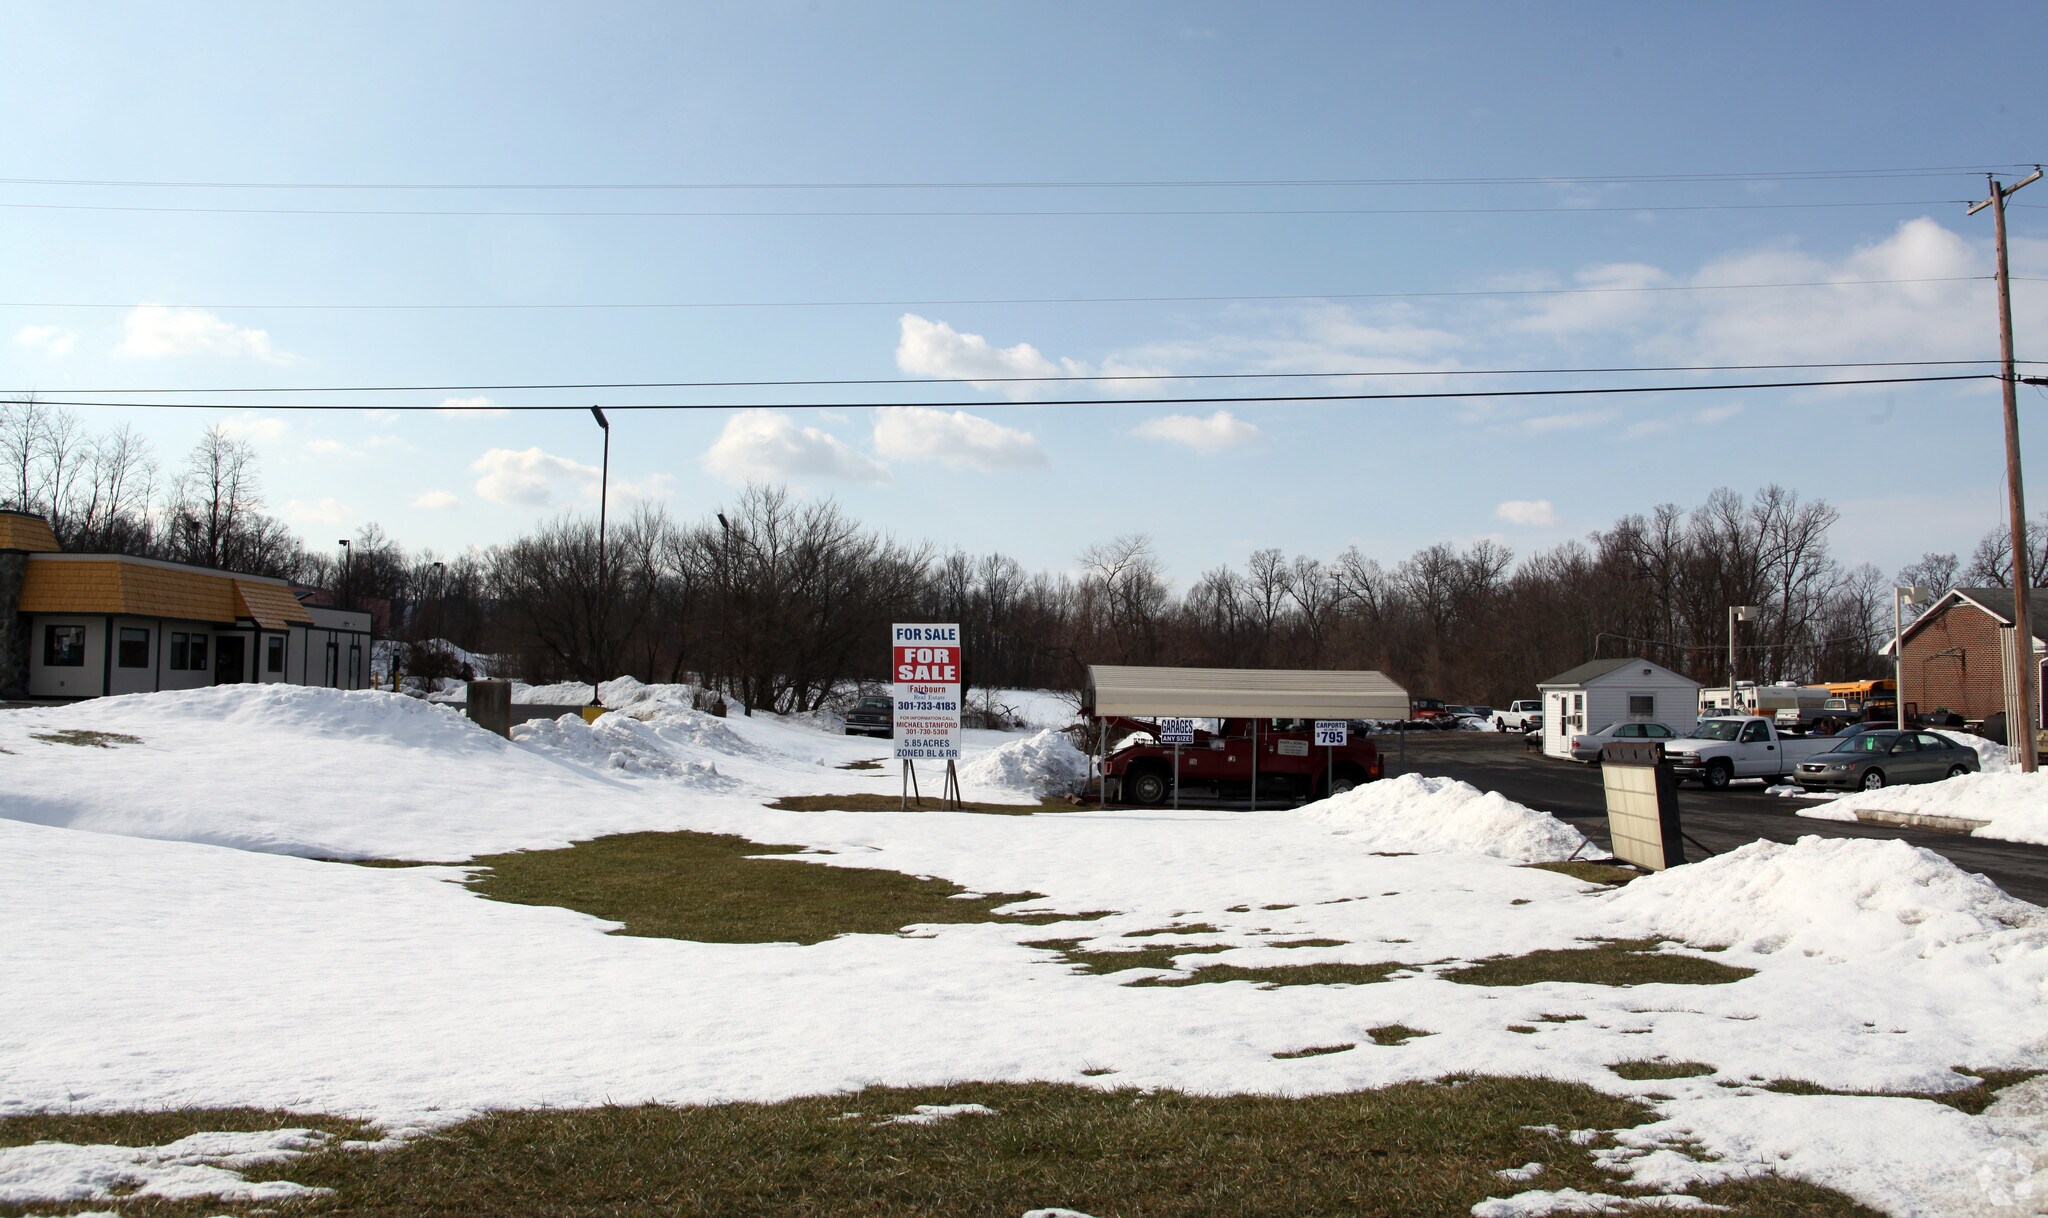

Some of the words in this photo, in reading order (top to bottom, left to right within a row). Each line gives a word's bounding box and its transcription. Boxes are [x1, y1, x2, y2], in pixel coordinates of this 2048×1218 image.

[896, 628, 922, 640] FOR
[924, 628, 956, 640] SALE
[904, 648, 950, 664] FOR
[898, 665, 956, 680] SALE
[909, 685, 946, 694] Fairbourn
[898, 701, 957, 711] 301-733-4183
[1161, 719, 1193, 734] GARAGES
[904, 739, 922, 747] 5.85
[923, 739, 950, 747] ACRES
[896, 749, 924, 757] ZONED
[927, 749, 937, 757] BL
[938, 749, 945, 757] &
[946, 749, 958, 757] RR
